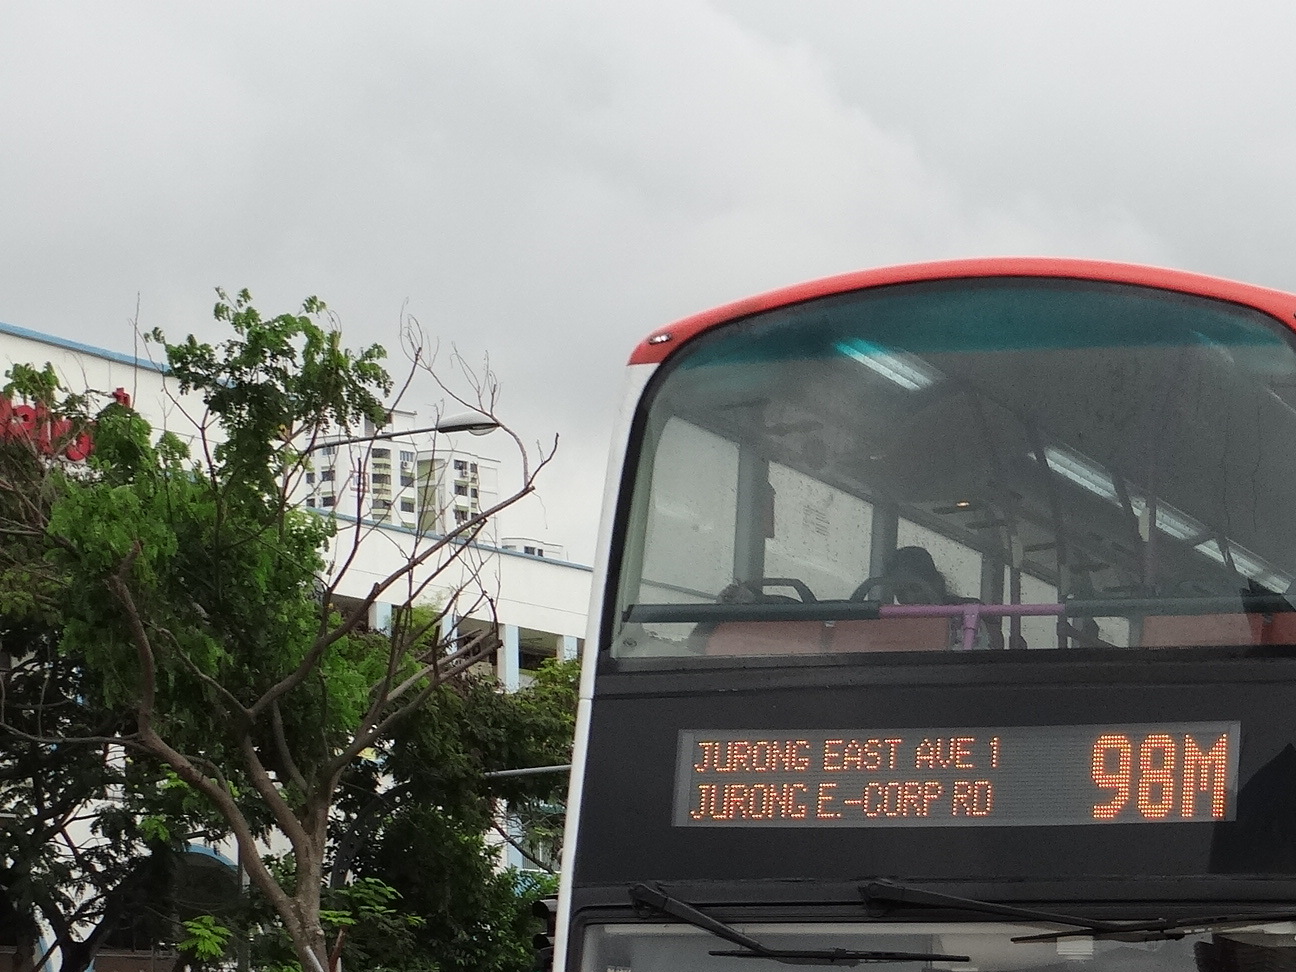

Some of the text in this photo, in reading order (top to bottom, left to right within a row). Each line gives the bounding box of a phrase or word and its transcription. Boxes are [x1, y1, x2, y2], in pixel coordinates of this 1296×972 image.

[693, 736, 1001, 772] JURONG EAST AVE 1
[1089, 733, 1229, 820] 98M
[689, 782, 807, 820] JURONG
[952, 780, 995, 817] RD
